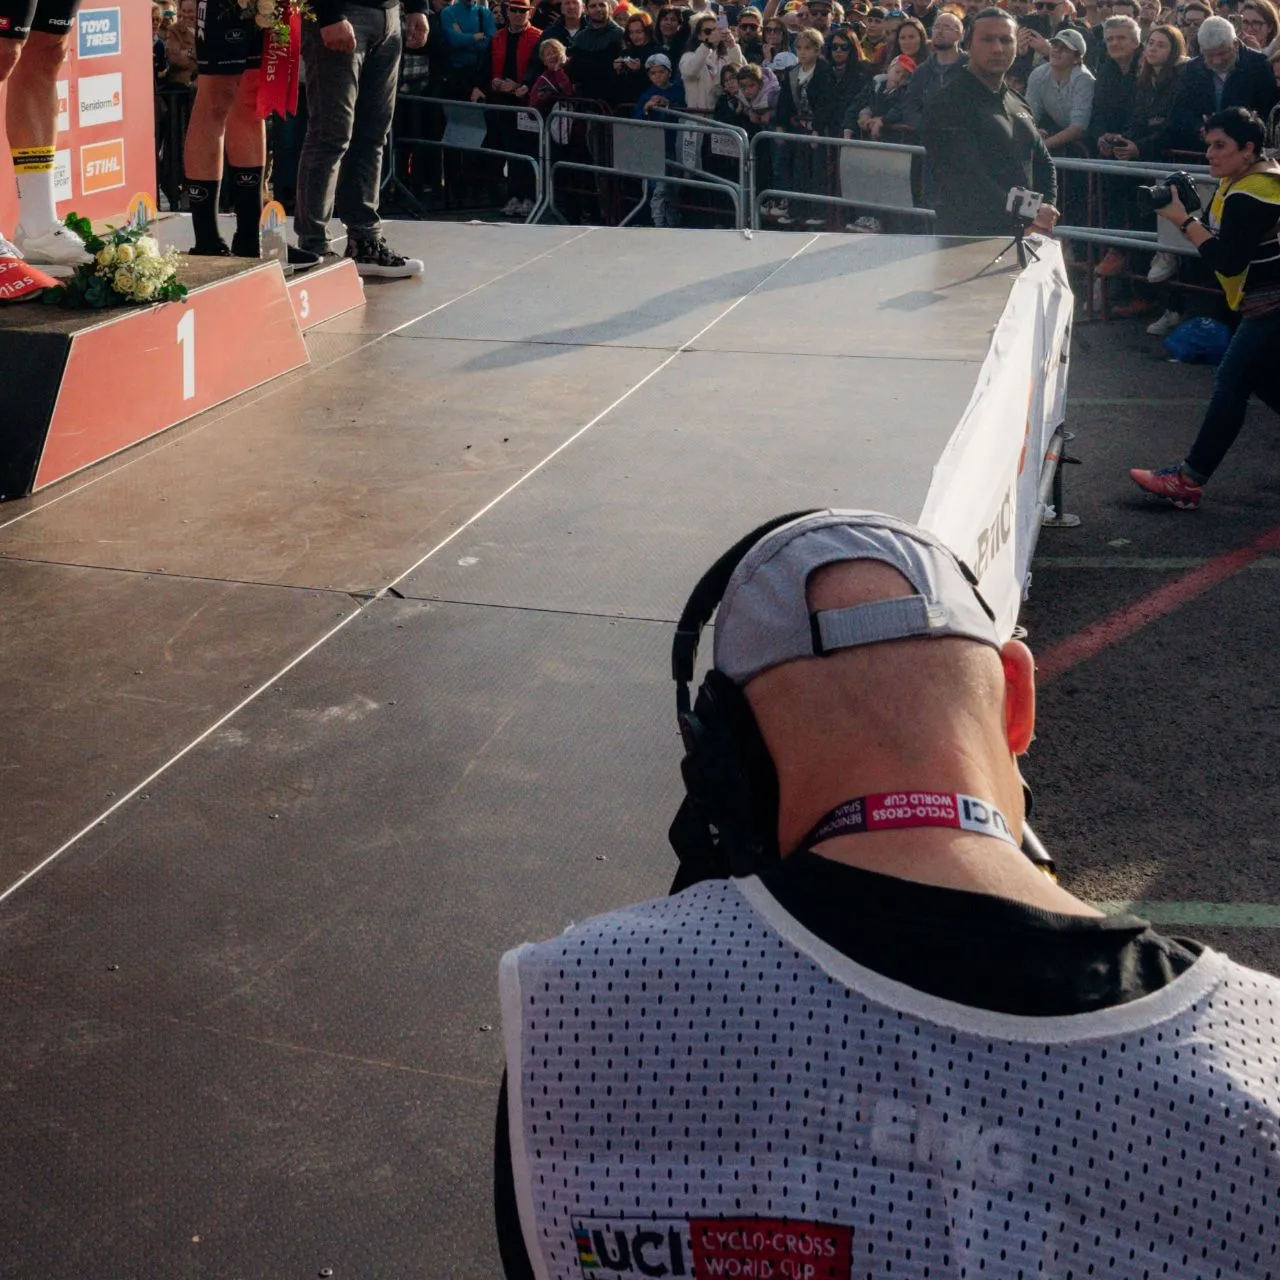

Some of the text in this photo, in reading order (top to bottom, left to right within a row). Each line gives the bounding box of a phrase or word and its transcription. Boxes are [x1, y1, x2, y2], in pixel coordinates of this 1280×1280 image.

[81, 19, 110, 33] TOYO
[86, 31, 117, 47] TIRES
[80, 98, 113, 112] Benidorm
[85, 156, 120, 177] STIHL
[299, 289, 309, 319] 3
[176, 308, 196, 400] 1
[884, 794, 953, 807] WORLD CUP
[872, 805, 956, 822] CYCLO-CROSS
[962, 797, 1014, 836] UCI
[592, 1229, 687, 1278] UCI
[701, 1231, 837, 1258] CYCLO-CROSS
[704, 1257, 817, 1280] WORLD CUP
